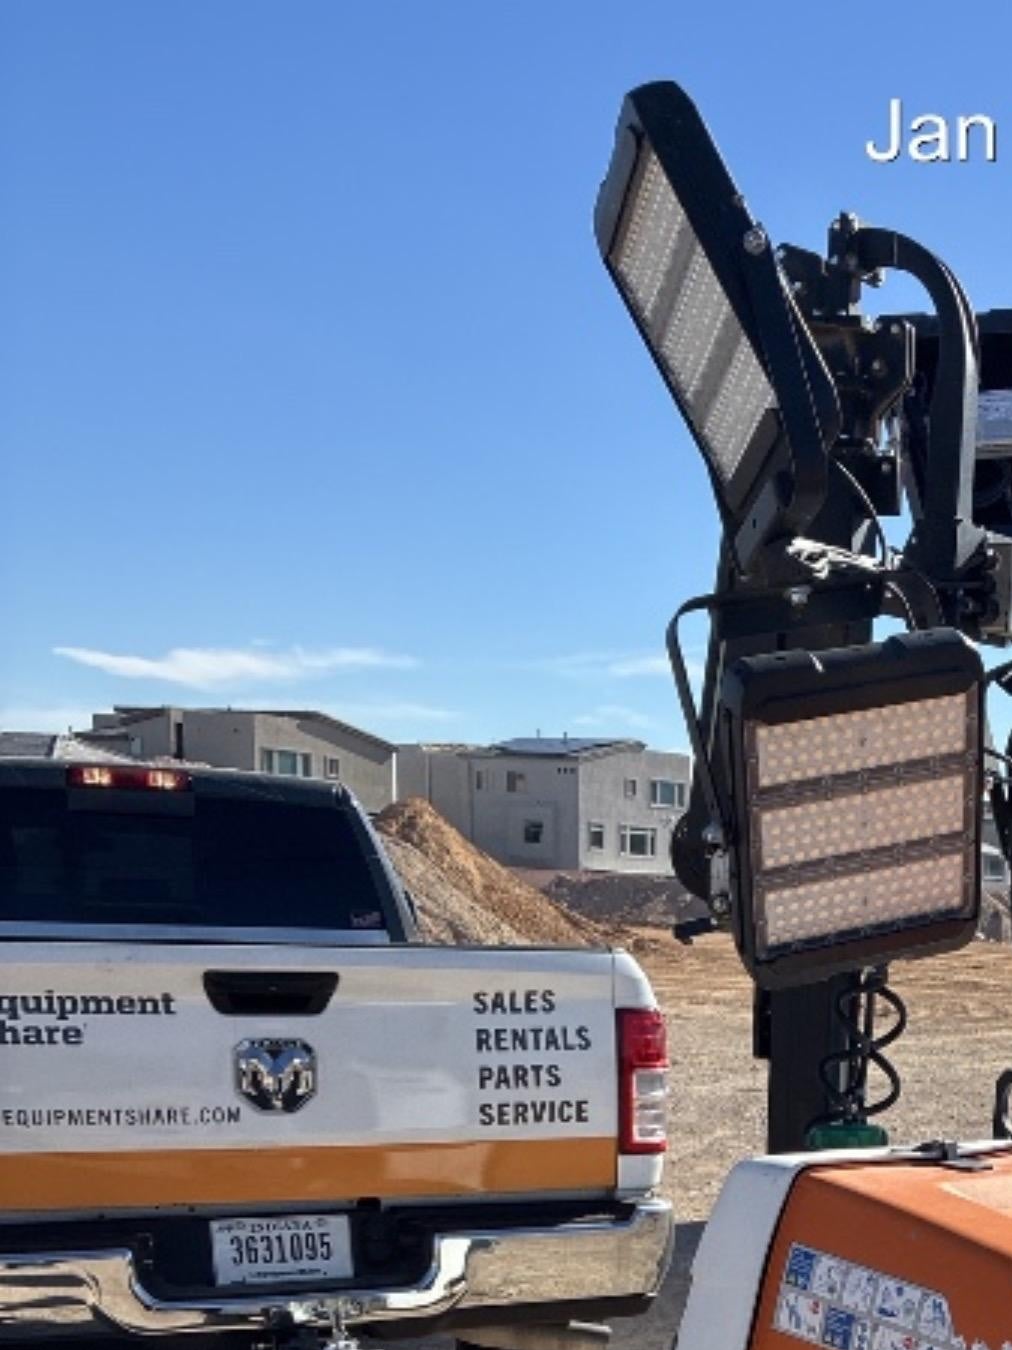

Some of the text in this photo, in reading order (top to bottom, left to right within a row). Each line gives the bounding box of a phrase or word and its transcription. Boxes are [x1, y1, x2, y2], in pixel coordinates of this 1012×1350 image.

[473, 990, 556, 1015] SALES
[476, 1026, 592, 1052] RENTALS
[479, 1065, 562, 1089] PARTS
[2, 1107, 241, 1128] EQUIPMENTSHARE.COM
[479, 1101, 589, 1126] SERVICE
[229, 1232, 332, 1265] 3631095
